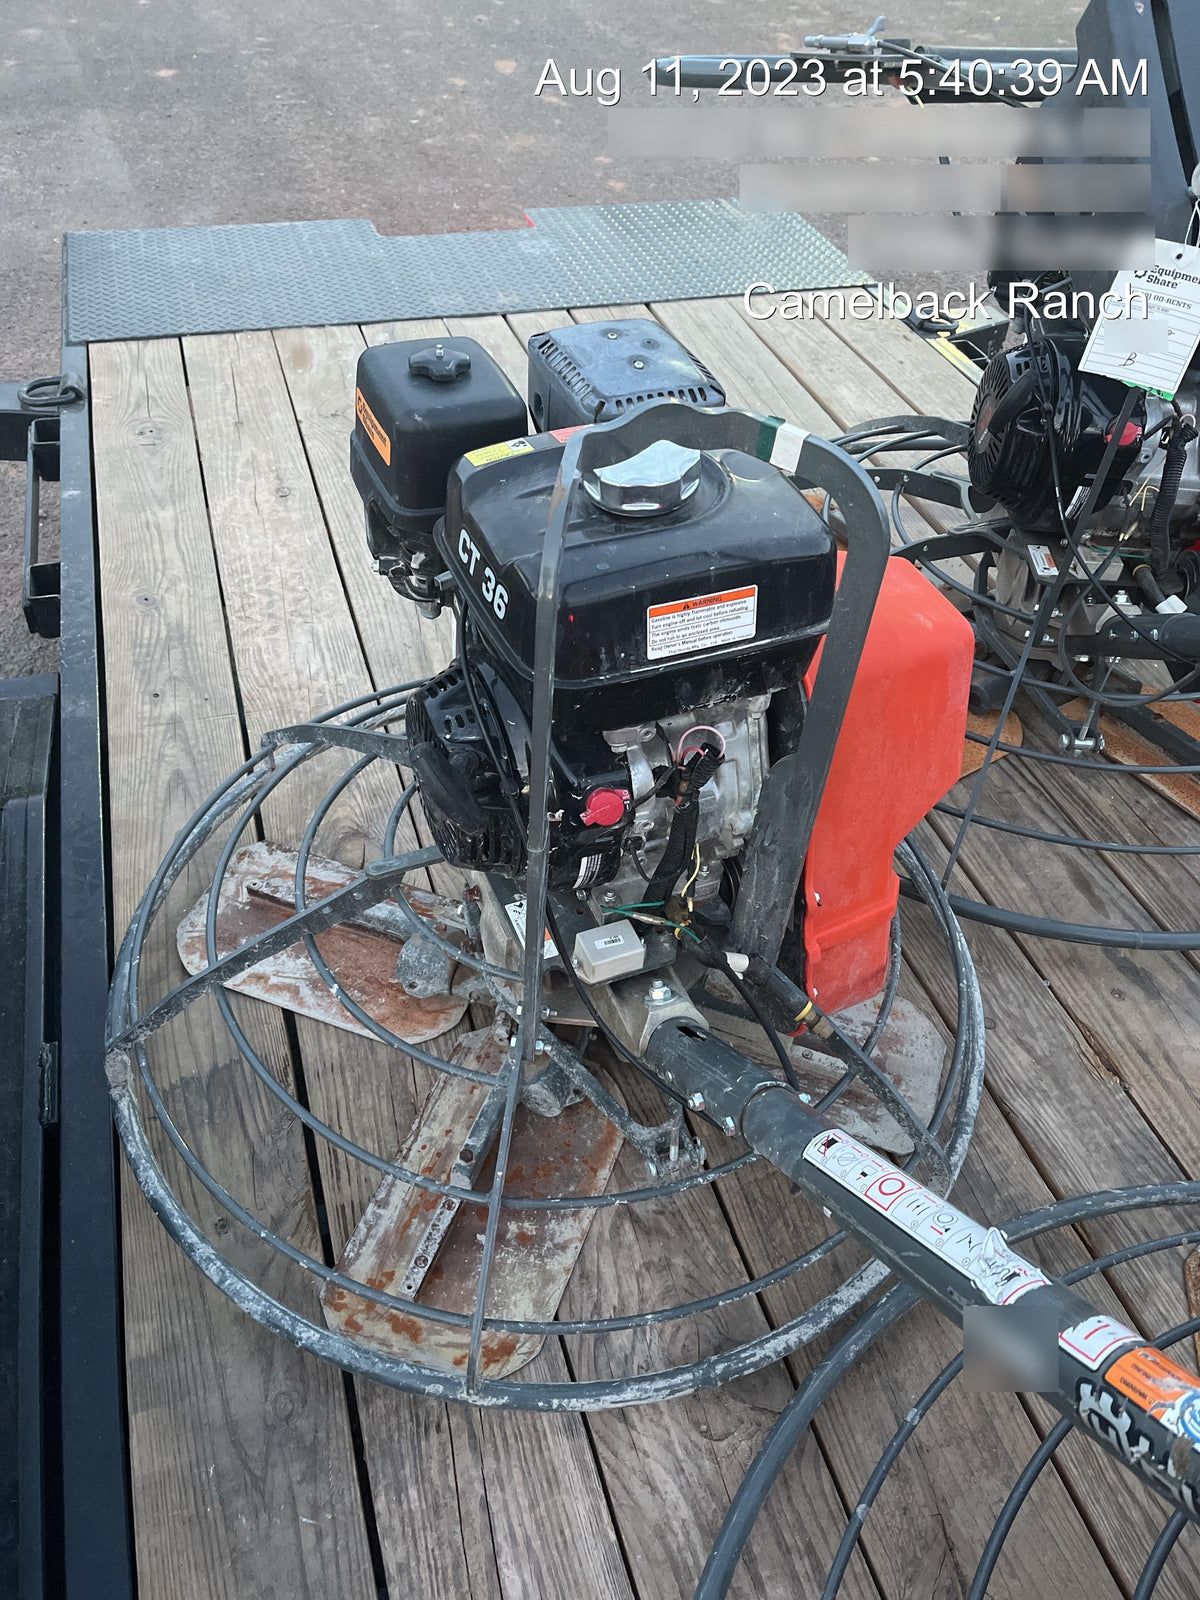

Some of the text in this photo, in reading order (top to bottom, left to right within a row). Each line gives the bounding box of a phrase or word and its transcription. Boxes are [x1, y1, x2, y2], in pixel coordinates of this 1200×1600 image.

[1146, 274, 1178, 289] Share
[458, 528, 509, 620] CT 36
[692, 595, 722, 607] WARNING
[651, 615, 670, 624] Gasoline
[691, 606, 715, 615] flammable
[661, 628, 676, 636] engine
[688, 628, 708, 637] enclosed
